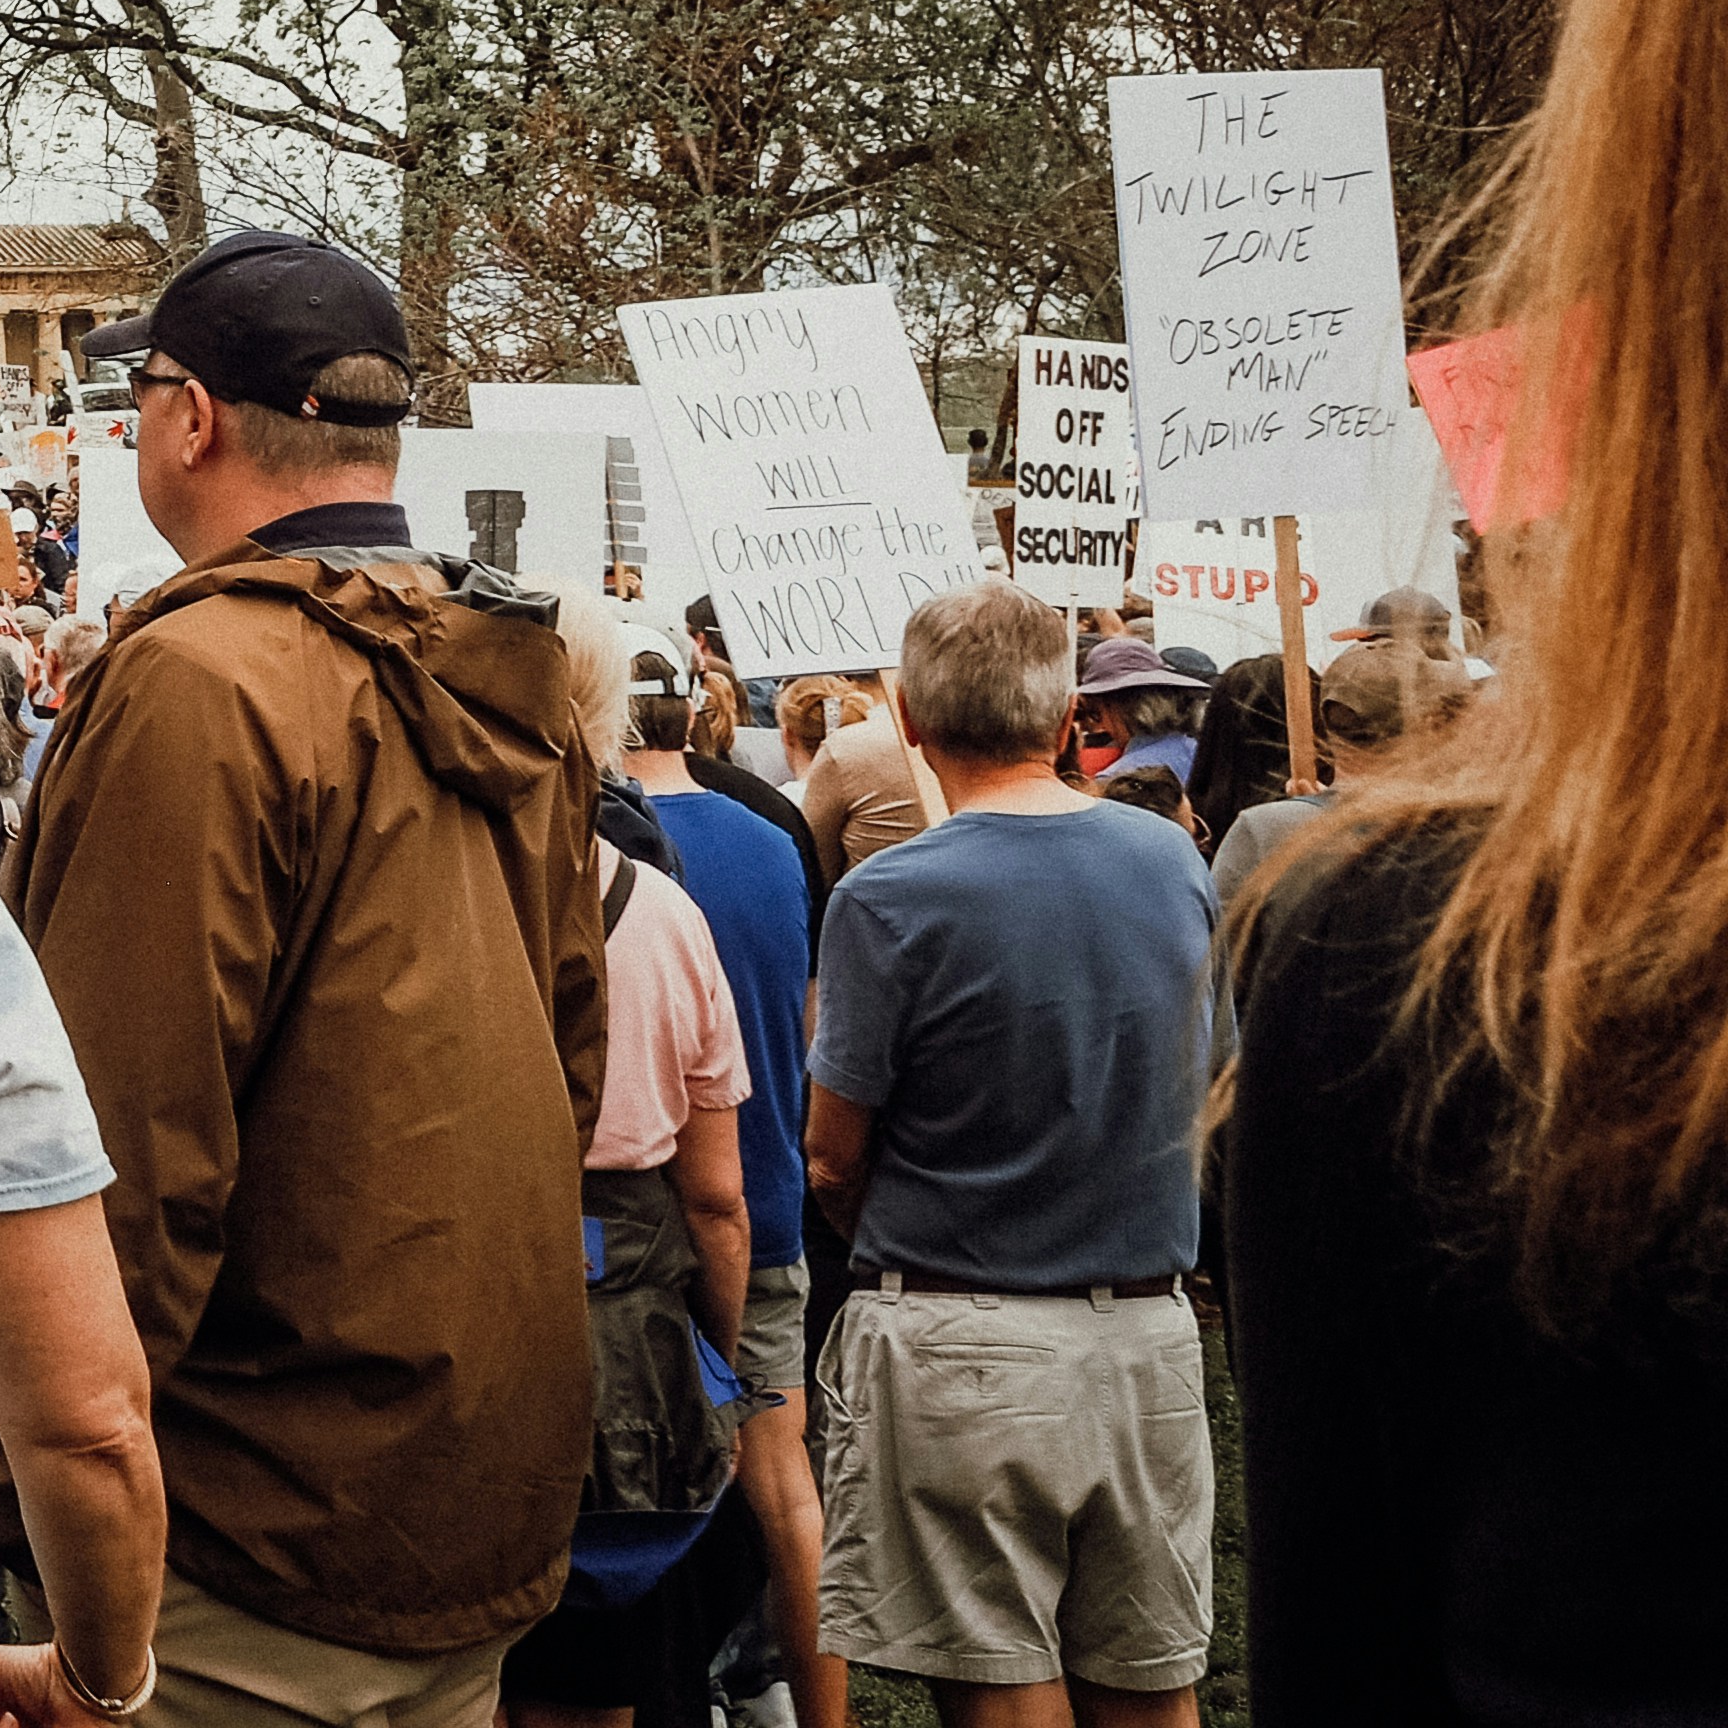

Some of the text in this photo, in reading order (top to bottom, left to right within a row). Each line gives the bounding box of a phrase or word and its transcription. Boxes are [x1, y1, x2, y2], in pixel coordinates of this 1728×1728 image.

[1187, 90, 1289, 154] THE
[1124, 170, 1374, 225] TWILIGHT
[1198, 224, 1316, 278] ZONE
[642, 307, 817, 375] Angry
[1034, 347, 1129, 393] HANDS
[677, 383, 872, 444] Women
[1055, 407, 1105, 447] OFF
[1157, 407, 1284, 471] ENDING
[1304, 404, 1398, 441] SPEECH
[755, 455, 858, 502] WILL
[1018, 462, 1116, 504] SOCIAL
[711, 508, 946, 576] Change the
[1016, 526, 1125, 567] SECURITY
[1155, 563, 1319, 606] STUPD
